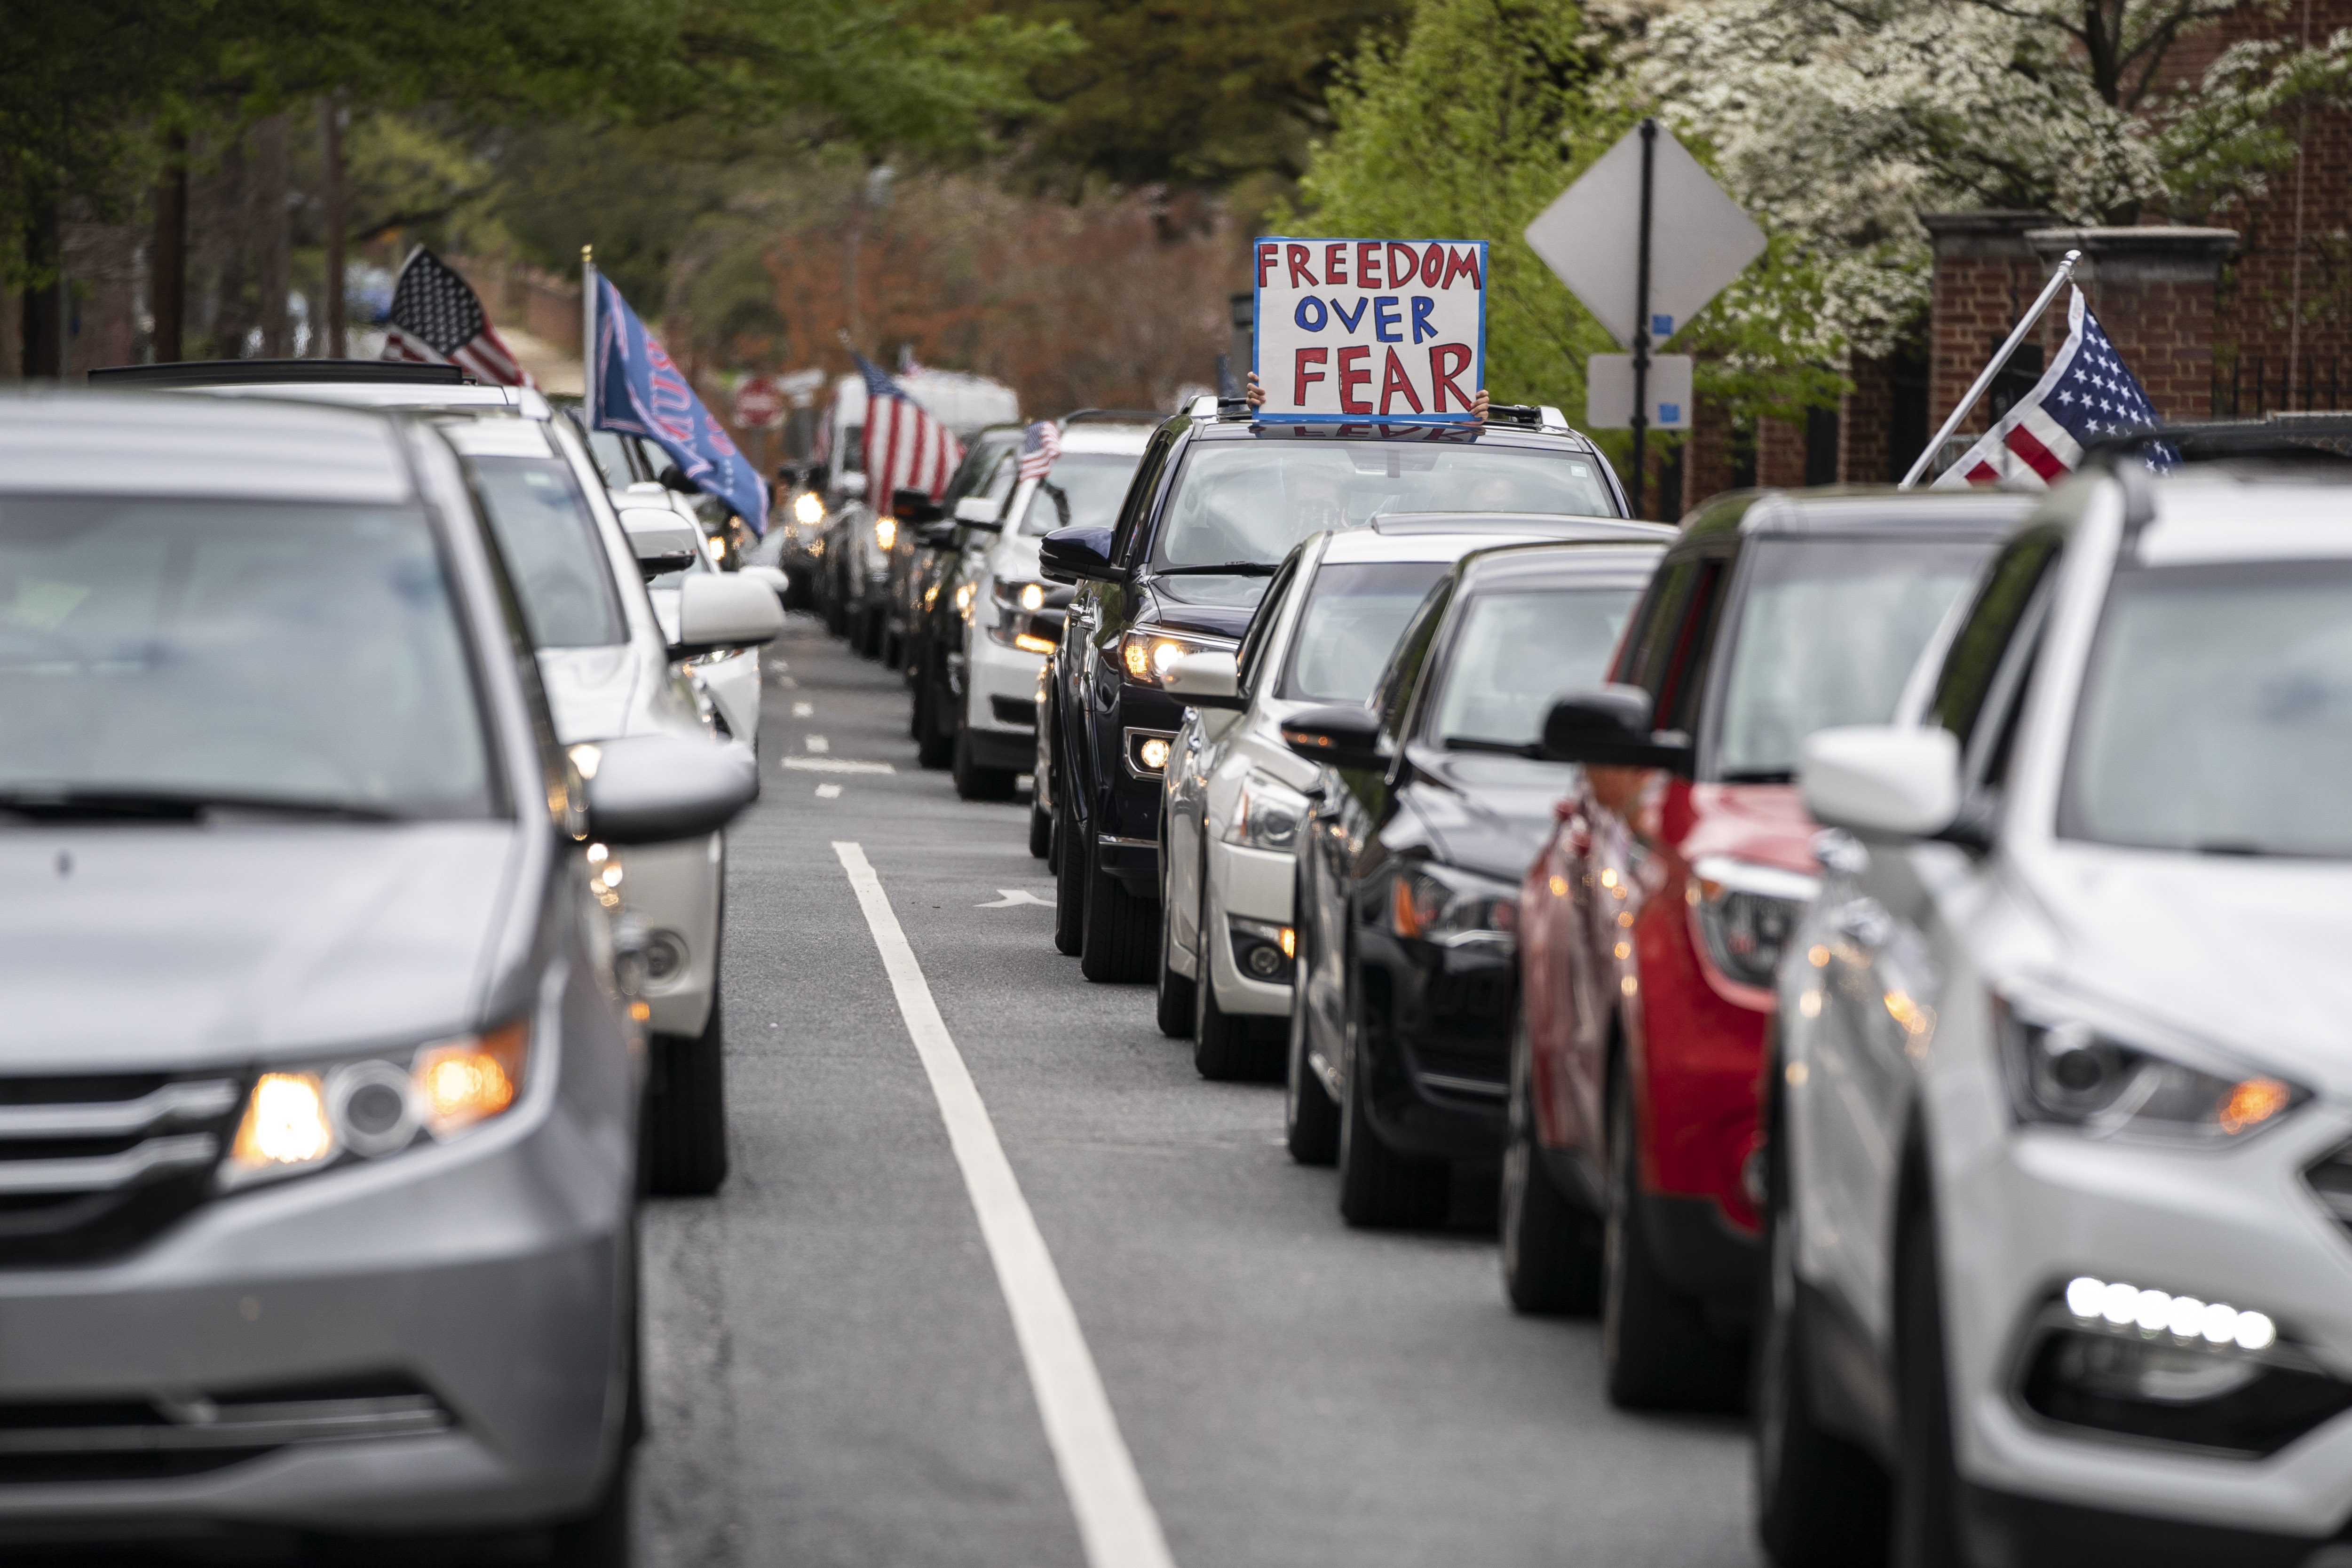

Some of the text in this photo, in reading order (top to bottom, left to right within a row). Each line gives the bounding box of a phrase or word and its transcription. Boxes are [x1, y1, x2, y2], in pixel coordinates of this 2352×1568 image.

[1258, 242, 1481, 290] FREEDOM
[1295, 295, 1438, 344] OVER
[1294, 343, 1472, 415] FEAR
